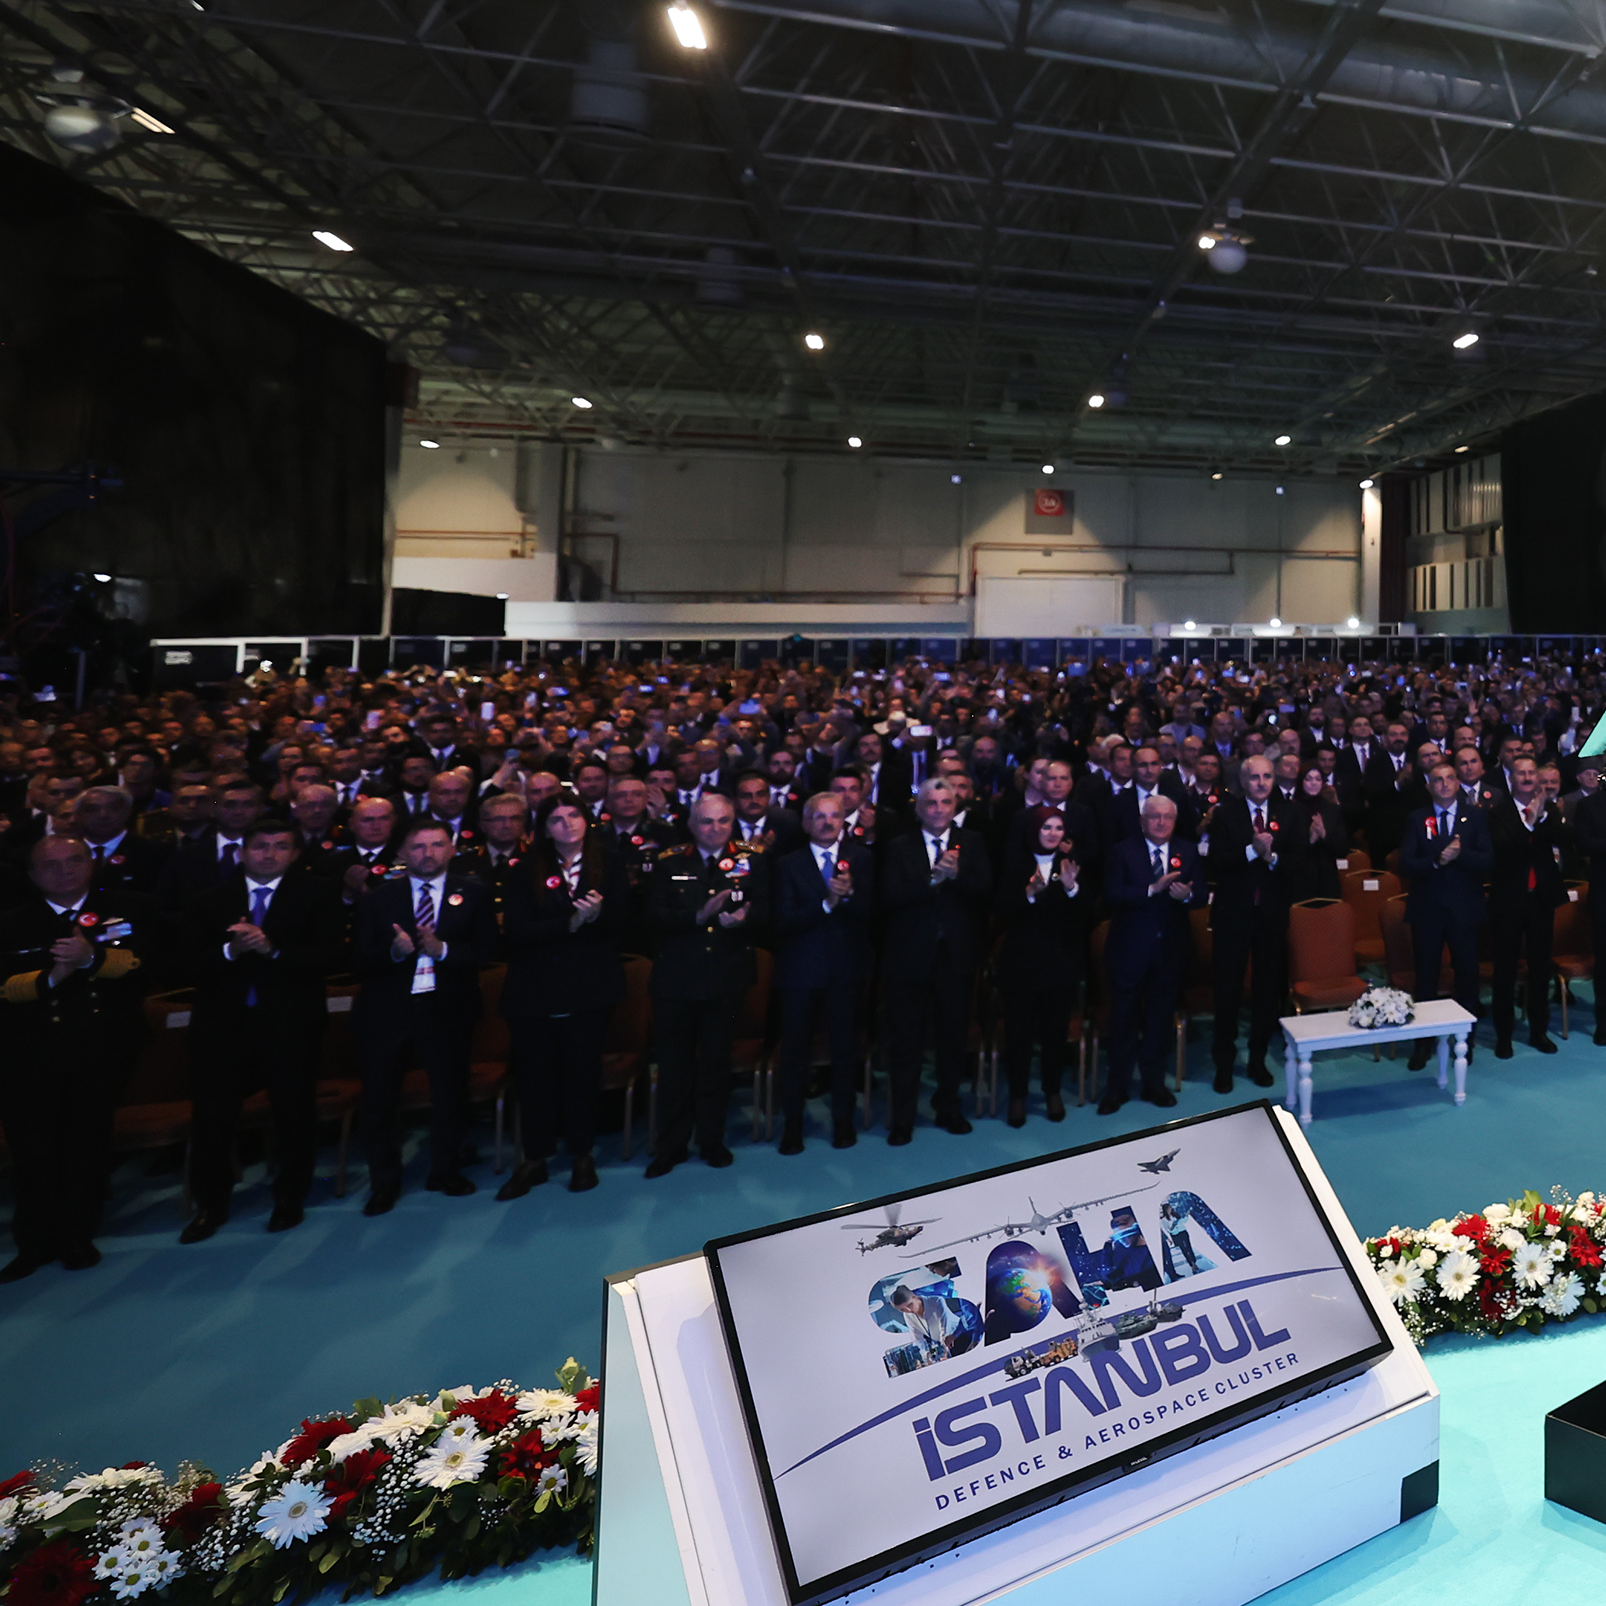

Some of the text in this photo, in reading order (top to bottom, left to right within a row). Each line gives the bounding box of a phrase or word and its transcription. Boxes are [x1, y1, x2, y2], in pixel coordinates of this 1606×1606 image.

[868, 1191, 1252, 1379] SAHA
[934, 1352, 1300, 1511] DEFENCE & AEROSPACE CLUSTER
